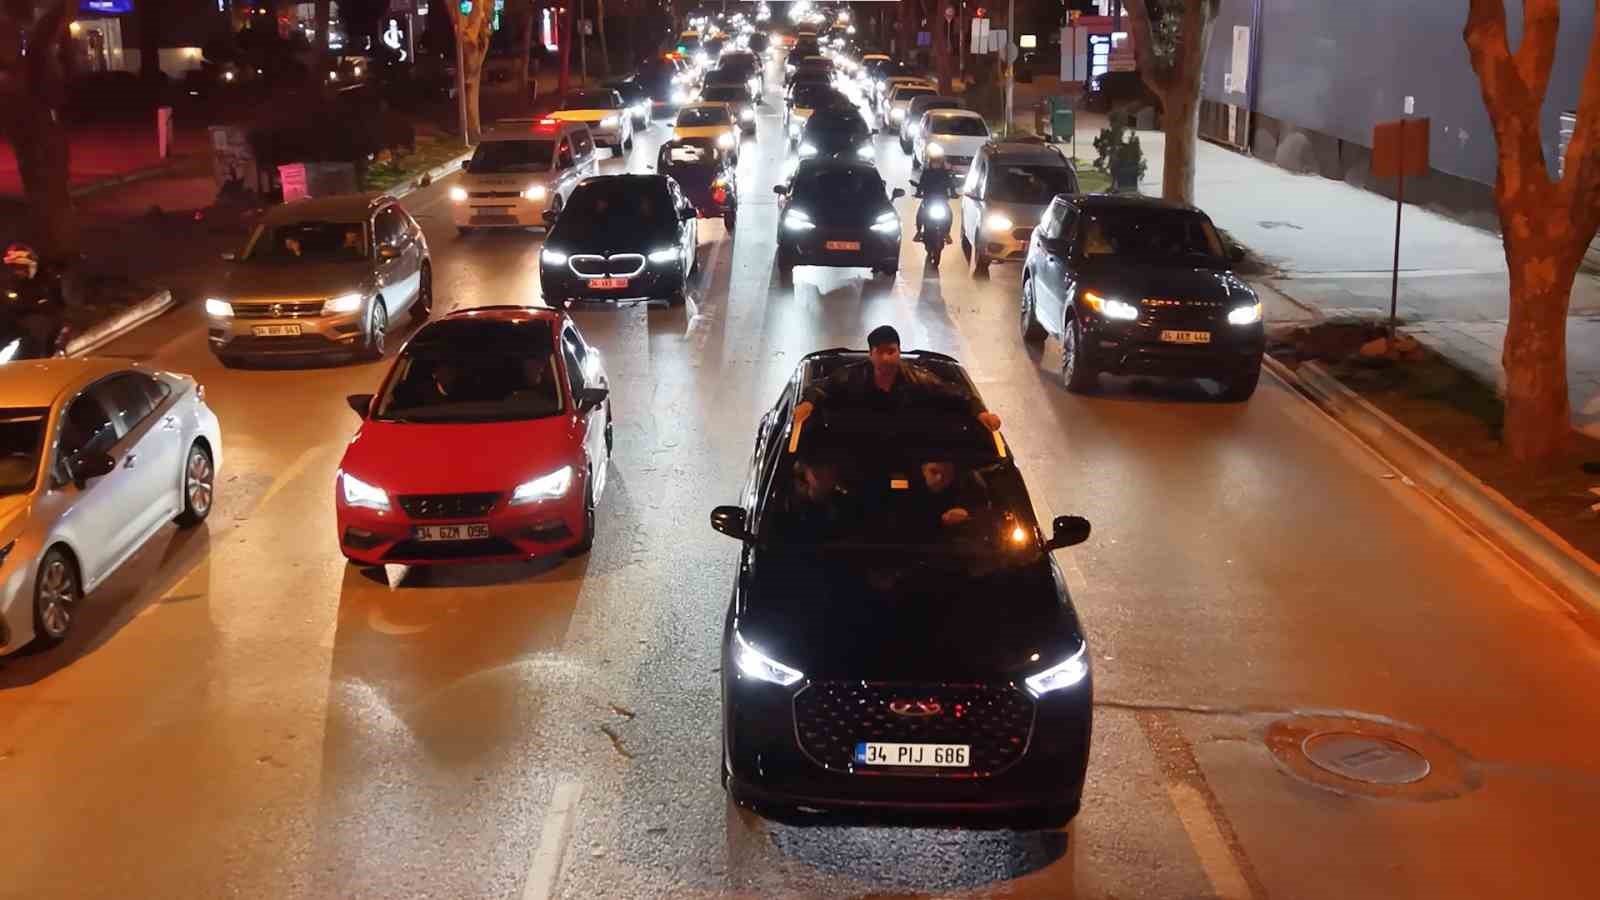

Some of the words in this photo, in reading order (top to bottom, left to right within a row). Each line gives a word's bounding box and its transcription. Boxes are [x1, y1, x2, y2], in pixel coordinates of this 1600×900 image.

[416, 527, 432, 539] 34
[440, 527, 460, 539] GZM
[867, 745, 887, 762] 34
[898, 746, 923, 763] PIJ
[934, 747, 965, 764] 686
